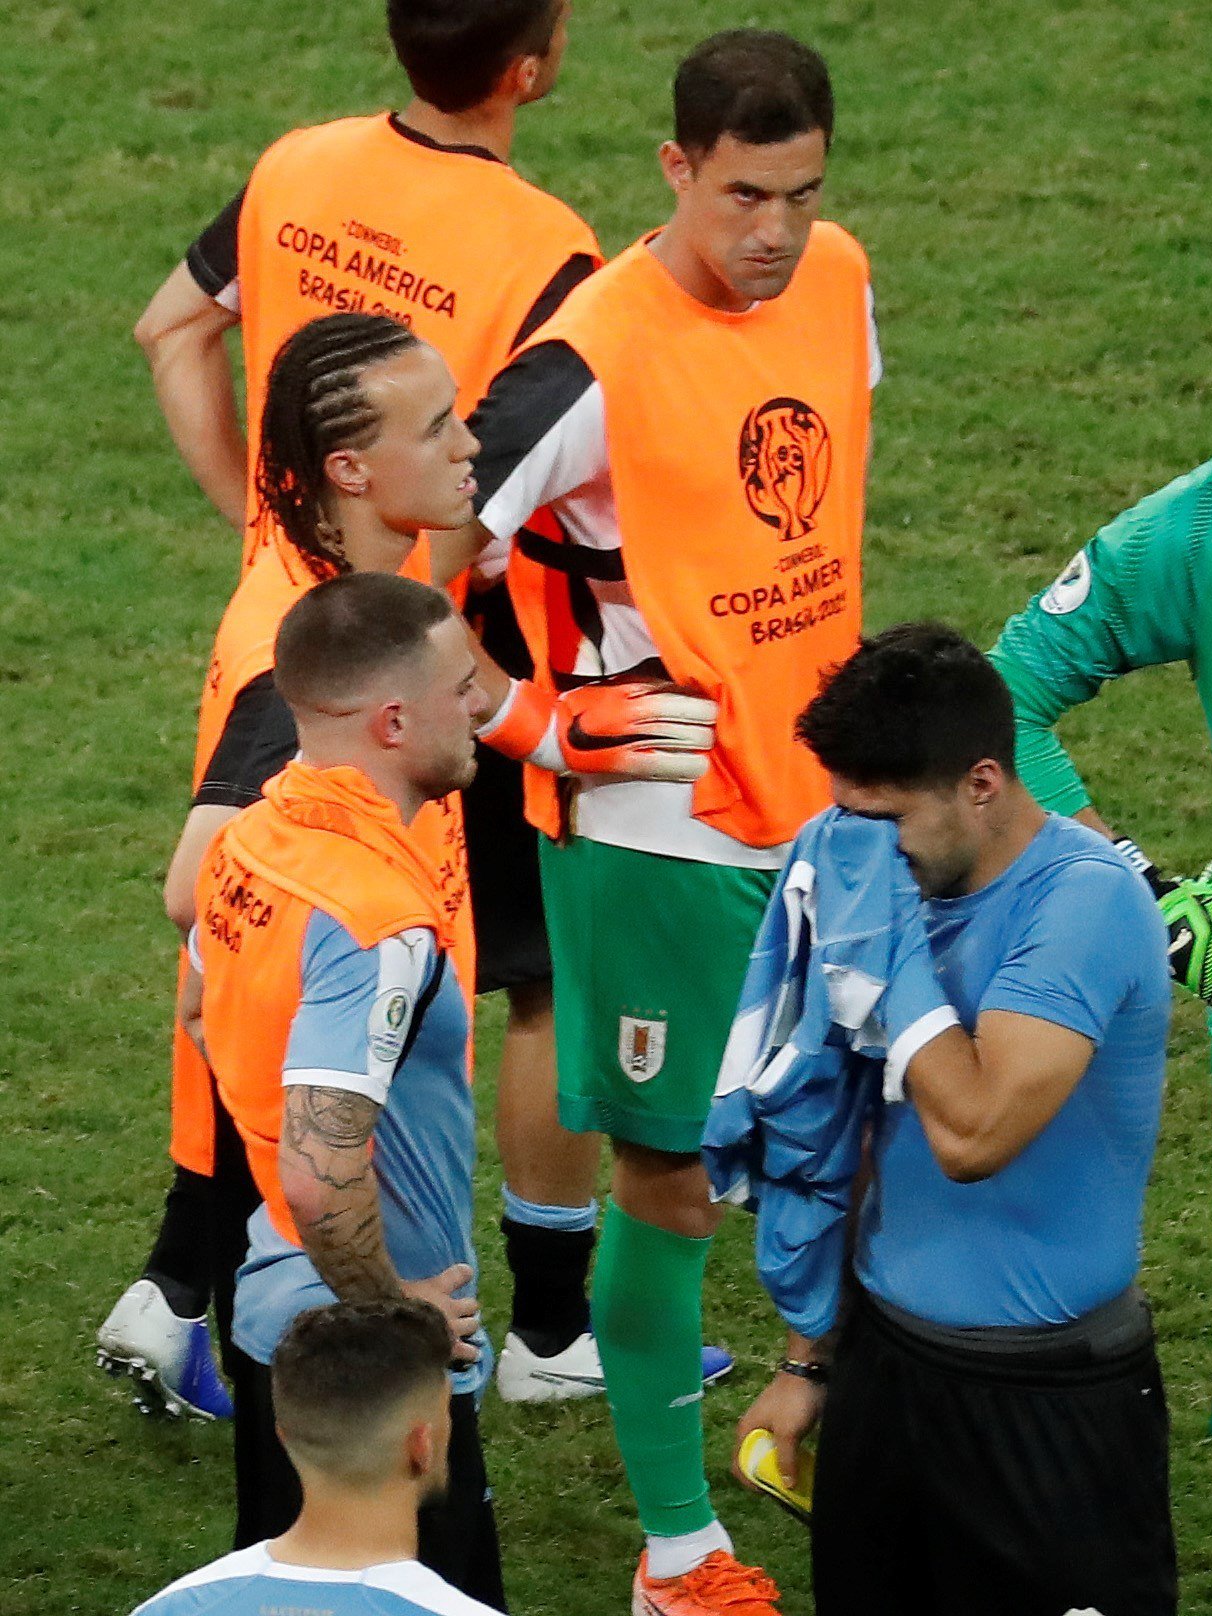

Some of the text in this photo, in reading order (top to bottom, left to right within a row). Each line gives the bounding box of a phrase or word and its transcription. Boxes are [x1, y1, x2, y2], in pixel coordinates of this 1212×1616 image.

[277, 222, 456, 319] COPA AMERICA
[709, 583, 786, 617] COPA
